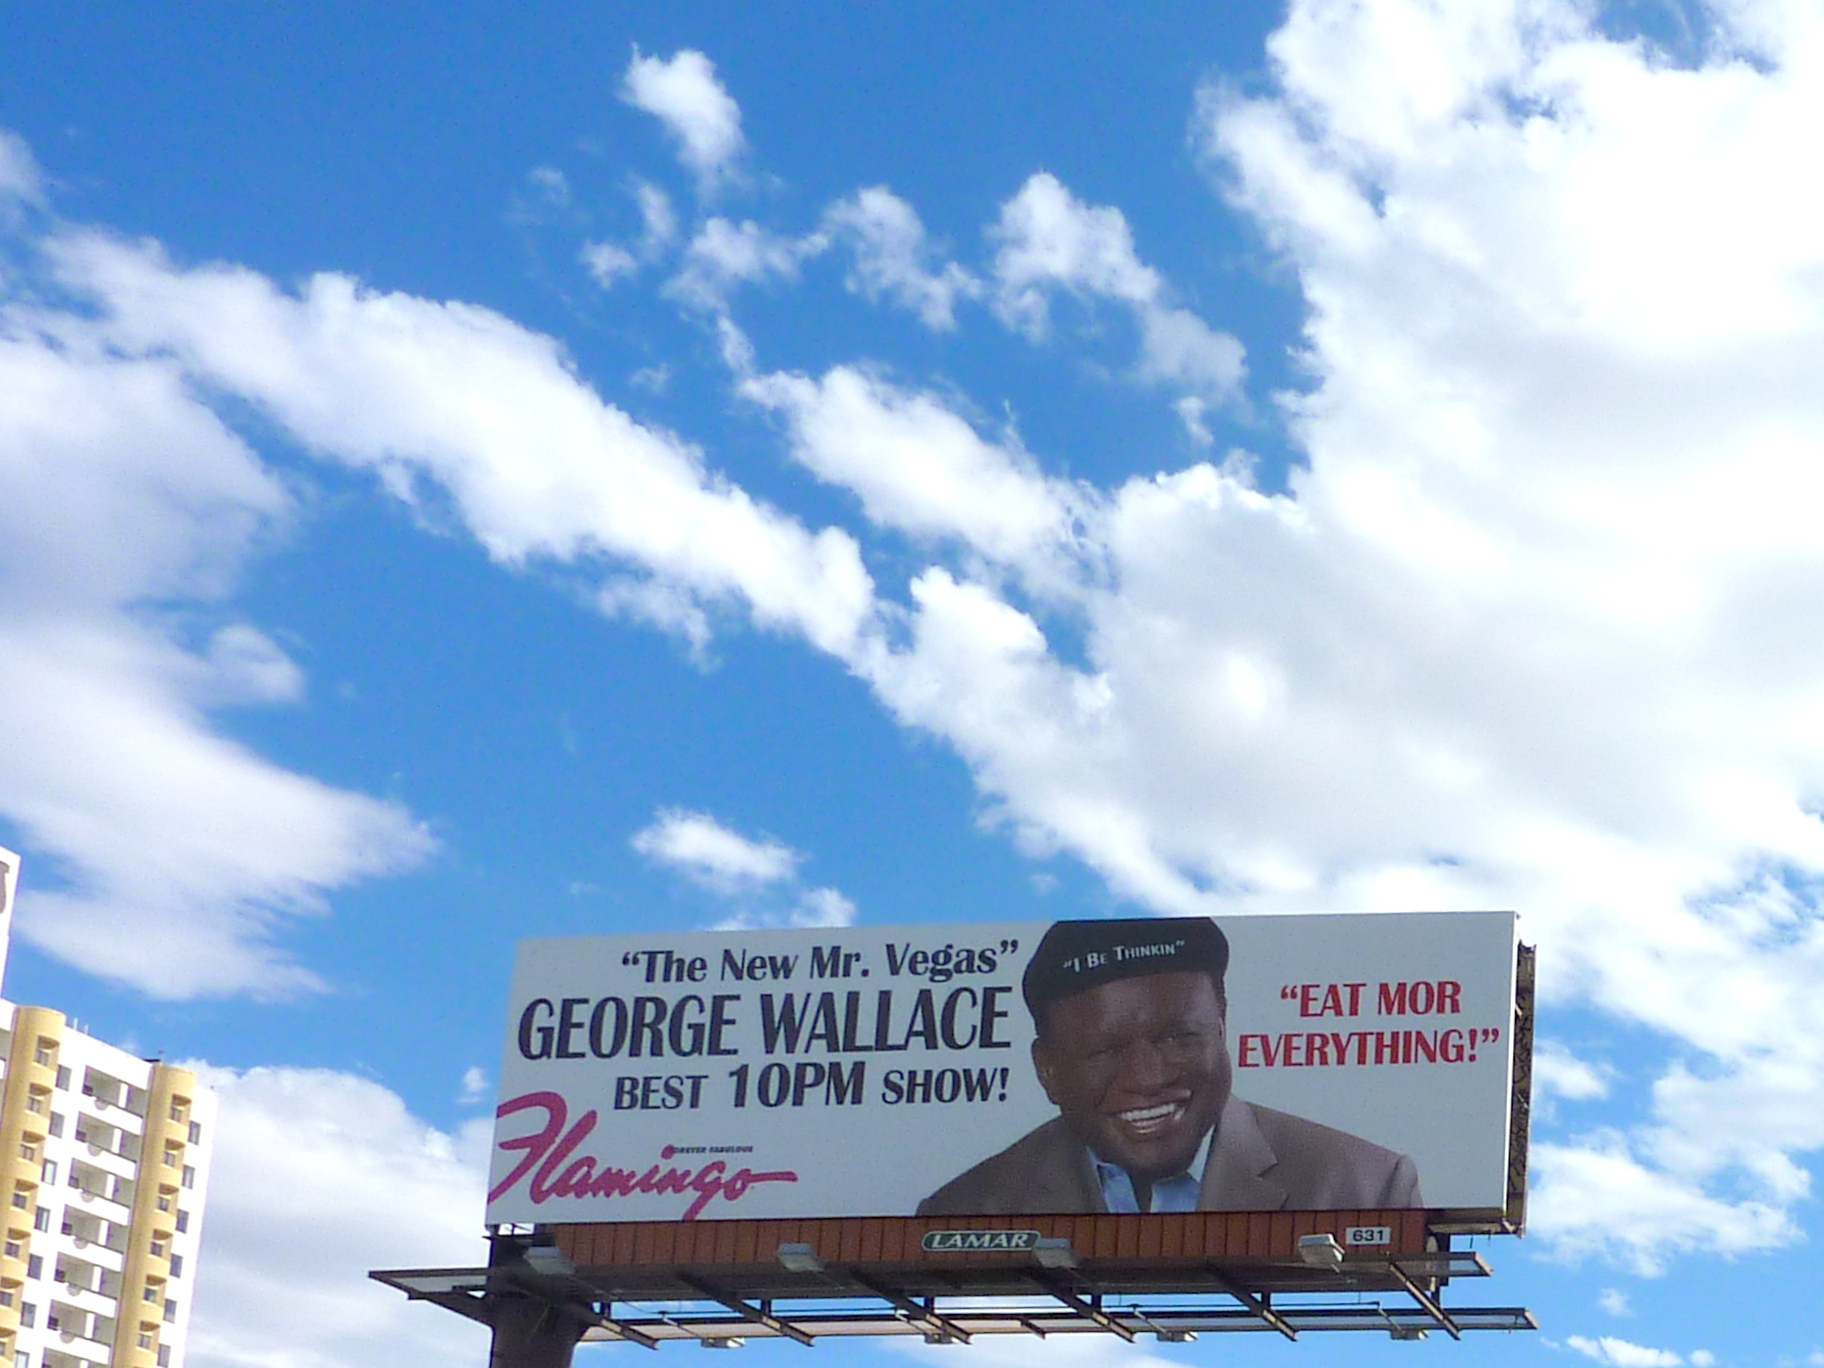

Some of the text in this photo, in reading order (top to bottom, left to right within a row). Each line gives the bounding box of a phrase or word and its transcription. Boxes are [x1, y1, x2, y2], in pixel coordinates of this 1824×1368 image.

[621, 938, 1019, 984] “The New Mr. Vegas”
[1280, 980, 1462, 1018] “EAT MOR
[517, 985, 1013, 1061] GEORGE WALLACE
[1237, 1027, 1500, 1069] EVERYTHING!”
[613, 1060, 1009, 1111] BEST 10PM SHOW!
[487, 1090, 798, 1221] Flamingo
[931, 1231, 1029, 1251] LAMAR
[1352, 1228, 1385, 1244] 631
